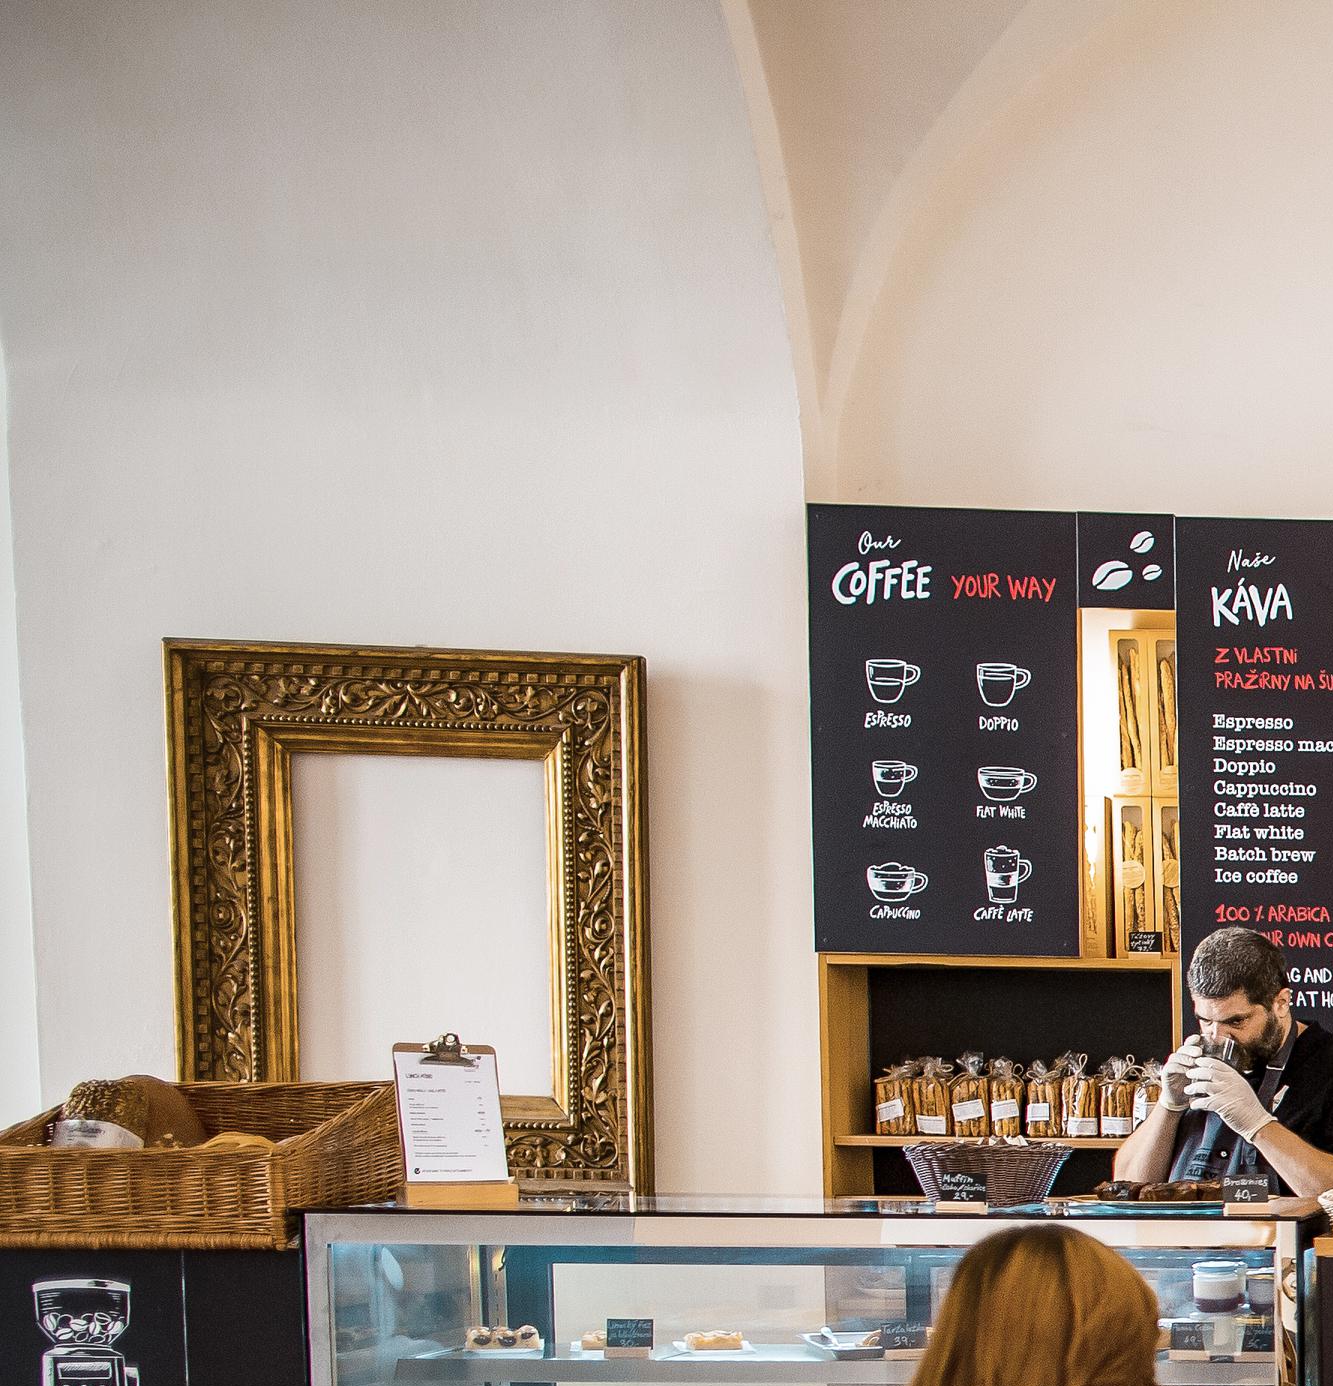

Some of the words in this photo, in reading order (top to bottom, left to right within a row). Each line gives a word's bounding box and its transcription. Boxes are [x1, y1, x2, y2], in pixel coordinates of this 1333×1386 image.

[858, 531, 901, 554] Our
[1228, 549, 1275, 572] Naše
[832, 560, 932, 604] COFFEE
[952, 573, 1000, 599] YOUR
[1007, 575, 1056, 602] WAY
[1211, 578, 1292, 627] KÁVA
[1215, 648, 1229, 663] Z
[1295, 674, 1314, 689] NA
[864, 710, 911, 728] ESPRESSO
[1213, 714, 1293, 731] Espresso
[1213, 736, 1293, 753] Espresso
[1213, 758, 1275, 775] Doppio
[1214, 780, 1316, 797] Cappuccino
[873, 801, 911, 815] ESPRESSO
[977, 806, 996, 818] FLAT
[1214, 802, 1259, 817] Caffè
[1264, 803, 1304, 817] latte
[1214, 825, 1250, 839] Flat
[1253, 826, 1304, 839] white
[1214, 847, 1267, 861] Batch
[1270, 848, 1316, 862] brew
[1215, 869, 1241, 882] Ice
[1246, 869, 1298, 883] coffee
[1007, 909, 1033, 922] LATTE
[1215, 904, 1250, 922] 100
[1288, 932, 1320, 947] OWN
[1304, 968, 1332, 983] AND
[1297, 991, 1318, 1007] AT
